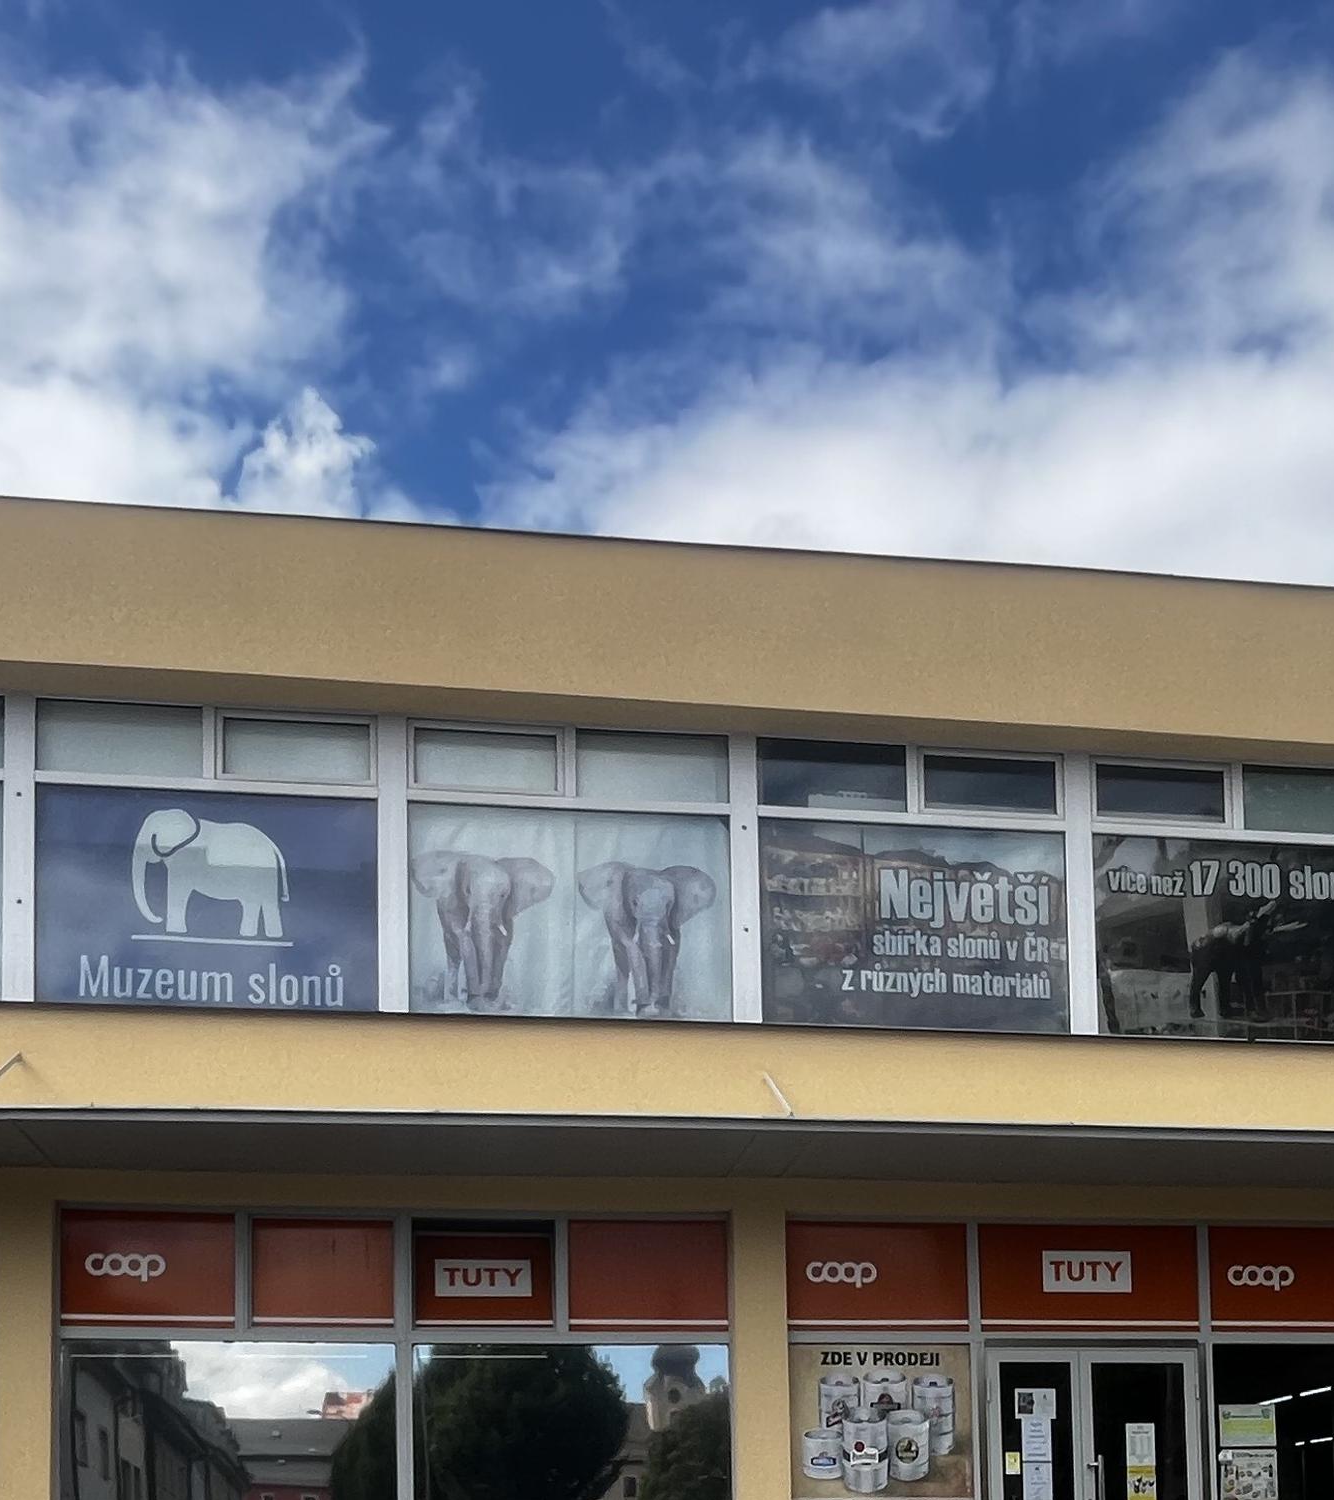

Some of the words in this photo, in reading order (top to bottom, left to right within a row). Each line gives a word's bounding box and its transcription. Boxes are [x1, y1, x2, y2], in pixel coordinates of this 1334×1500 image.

[1108, 866, 1147, 894] více
[1150, 871, 1185, 896] než
[1189, 860, 1219, 896] 17
[1228, 860, 1281, 899] 300
[879, 868, 1050, 929] Největší
[873, 929, 942, 957] sbírka
[947, 931, 1001, 961] slonů
[1006, 940, 1018, 960] v
[1024, 930, 1050, 963] ČR
[79, 955, 234, 1003] Muzeum
[248, 962, 344, 1007] slonů
[841, 969, 855, 991] z
[860, 962, 947, 998] různých
[953, 971, 1051, 1000] materiálů
[85, 1252, 166, 1282] coop
[443, 1267, 524, 1288] TUTY
[806, 1260, 878, 1289] coop
[1049, 1260, 1124, 1283] TUTY
[1227, 1264, 1295, 1292] coop
[820, 1351, 853, 1366] ZDE
[856, 1351, 868, 1366] V
[873, 1351, 940, 1367] PRODEJI
